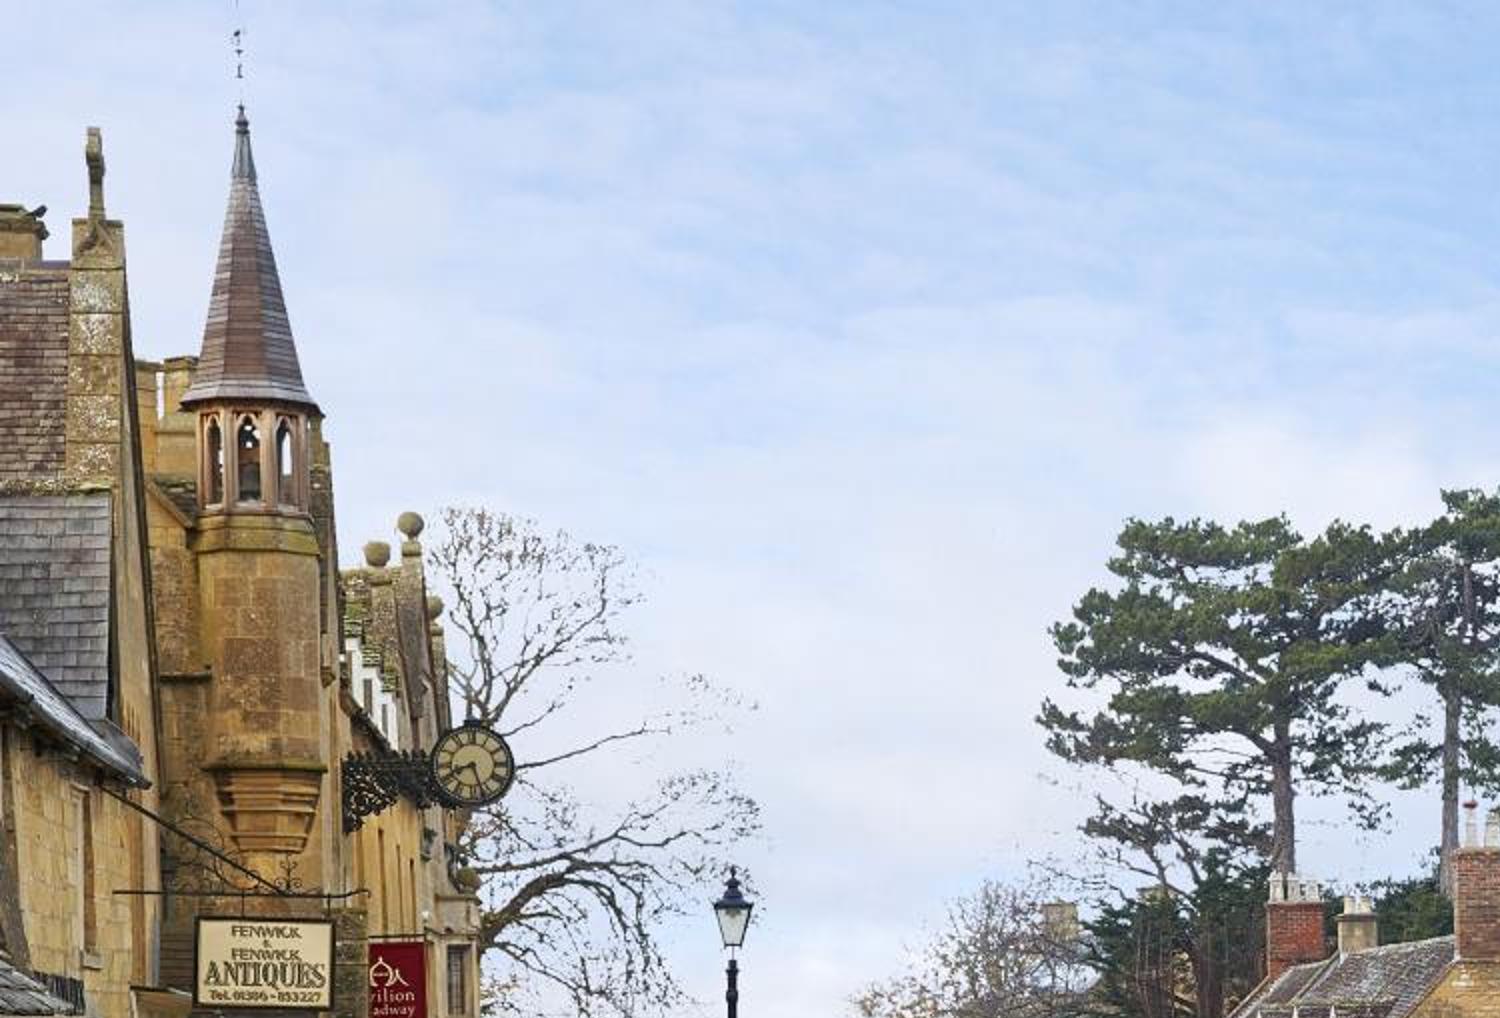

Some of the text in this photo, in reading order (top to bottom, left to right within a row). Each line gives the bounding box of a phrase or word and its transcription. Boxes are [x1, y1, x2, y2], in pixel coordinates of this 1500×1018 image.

[231, 925, 302, 939] FENWICK
[263, 939, 272, 948] &
[231, 948, 302, 962] FENWICK
[204, 960, 326, 990] ANTIQUES
[370, 988, 415, 1002] ilion
[373, 1003, 415, 1018] adway
